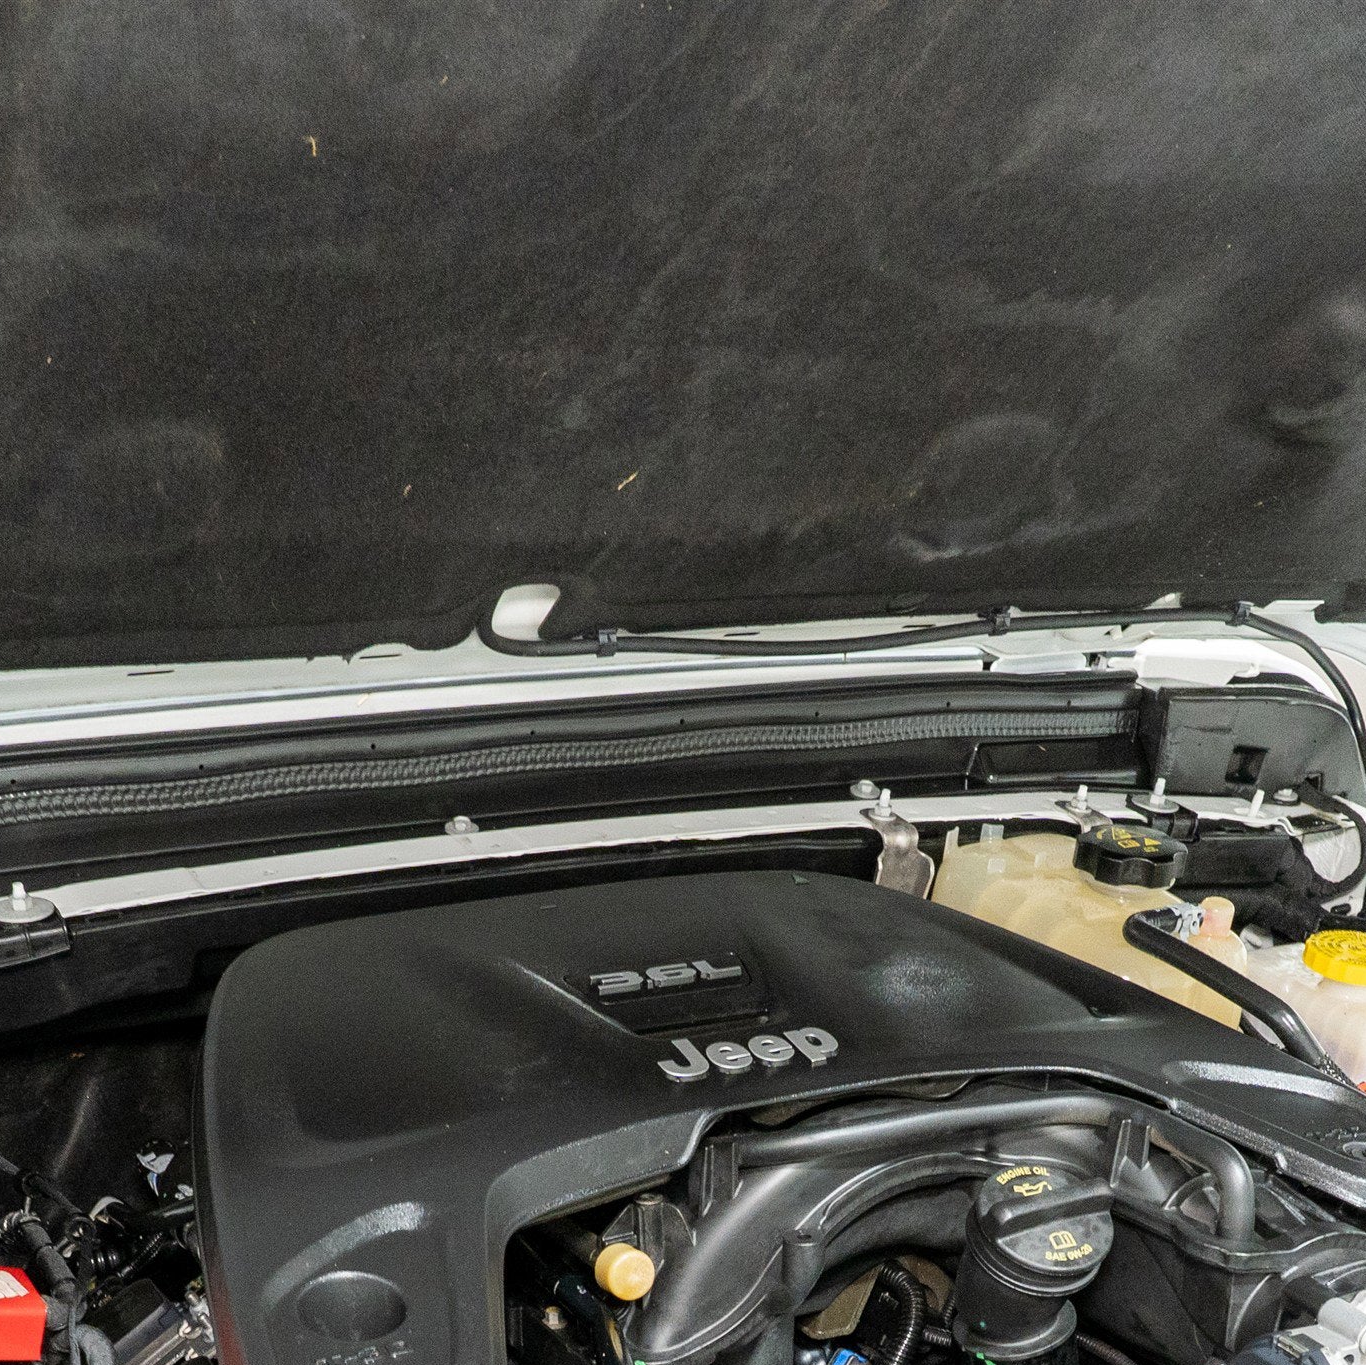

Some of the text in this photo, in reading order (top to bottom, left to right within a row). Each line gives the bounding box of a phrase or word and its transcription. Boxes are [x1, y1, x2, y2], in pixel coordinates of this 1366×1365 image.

[590, 959, 742, 996] 3.6L
[657, 1026, 839, 1082] Jeep
[996, 1166, 1051, 1186] ENGINE OIL
[1045, 1251, 1067, 1261] SAE
